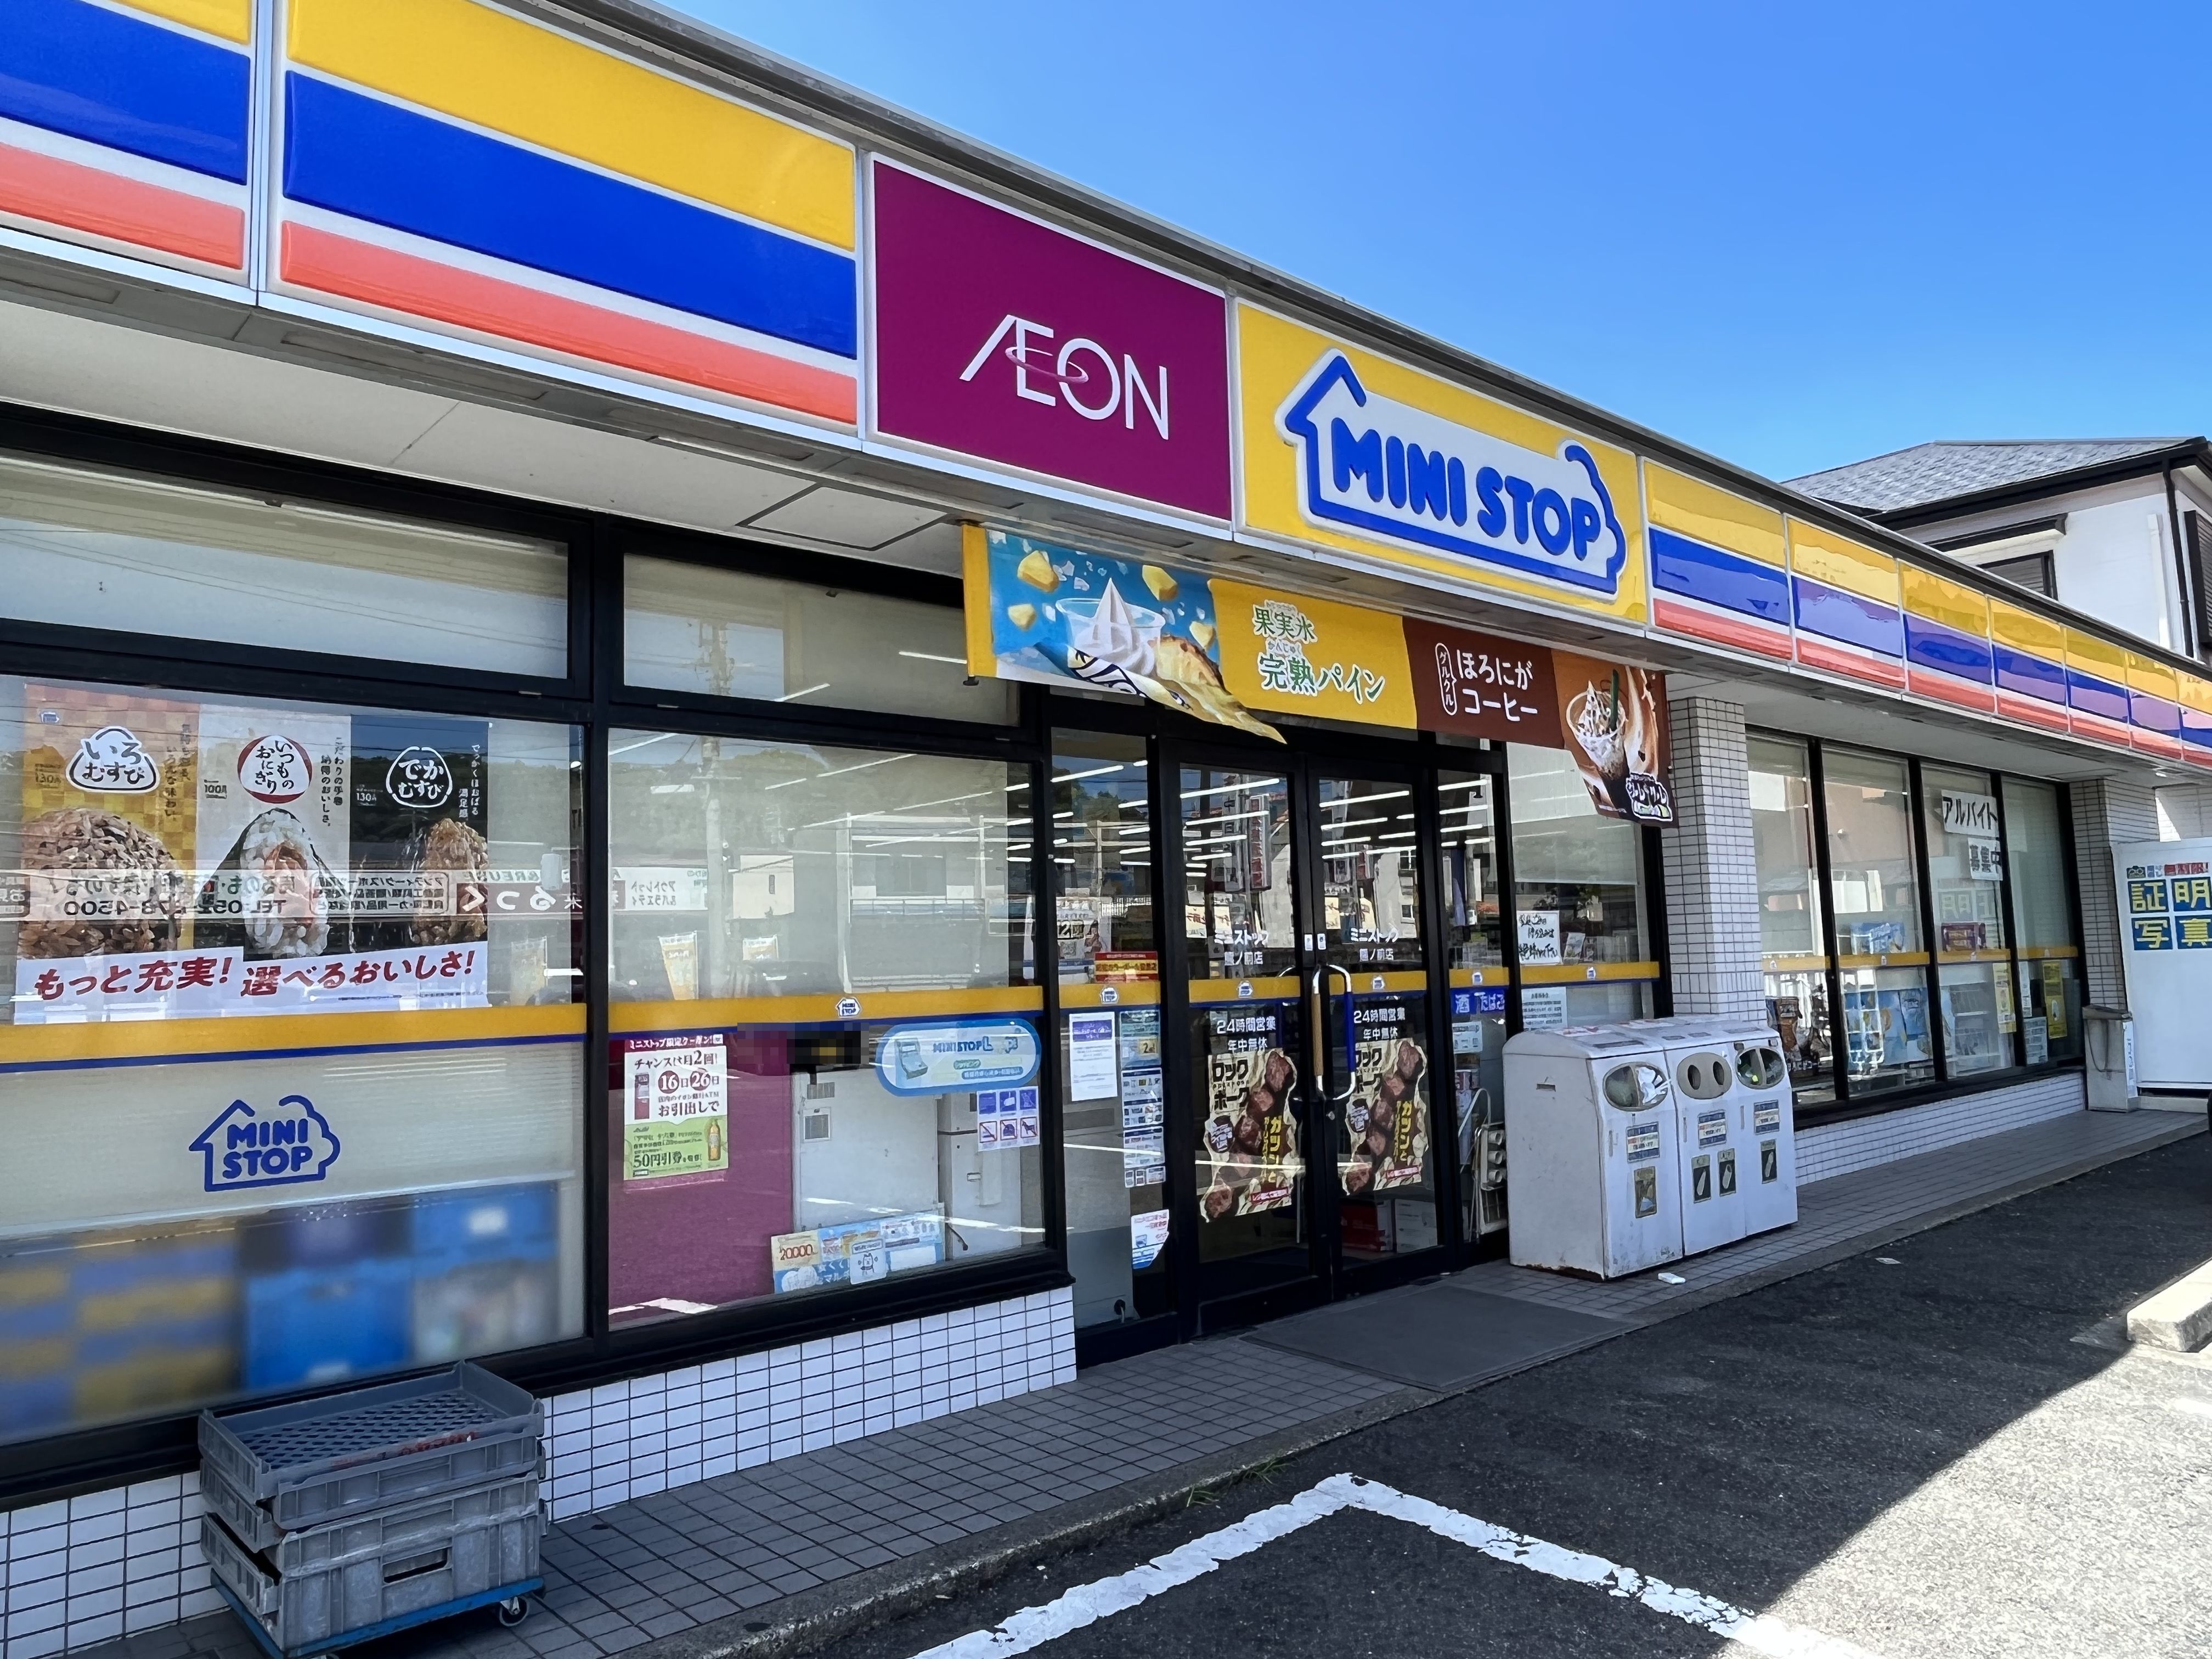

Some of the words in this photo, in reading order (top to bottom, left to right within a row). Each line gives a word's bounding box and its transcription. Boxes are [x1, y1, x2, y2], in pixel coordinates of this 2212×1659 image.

[1331, 417, 1466, 527] MINI
[1476, 465, 1601, 561] STOP
[1254, 607, 1316, 641] 果実氷
[1259, 653, 1384, 701] 完熟パイン
[1457, 649, 1533, 690] ほろにが
[1462, 689, 1538, 721] コーヒー
[84, 741, 142, 765] いろ
[255, 745, 277, 794] おにぎり
[275, 740, 295, 789] いつもの
[398, 759, 444, 780] でか
[82, 761, 145, 785] むすび
[398, 780, 444, 799] むすび
[1943, 796, 1997, 830] アルバイト
[2131, 879, 2211, 911] 証明
[2135, 918, 2212, 949] 写真
[35, 956, 233, 1000] もっと充実!
[240, 950, 476, 997] 選べるおいしさ!
[1217, 1015, 1277, 1034] 24時間営業
[227, 1118, 308, 1150] MINI
[222, 1146, 313, 1179] STOP
